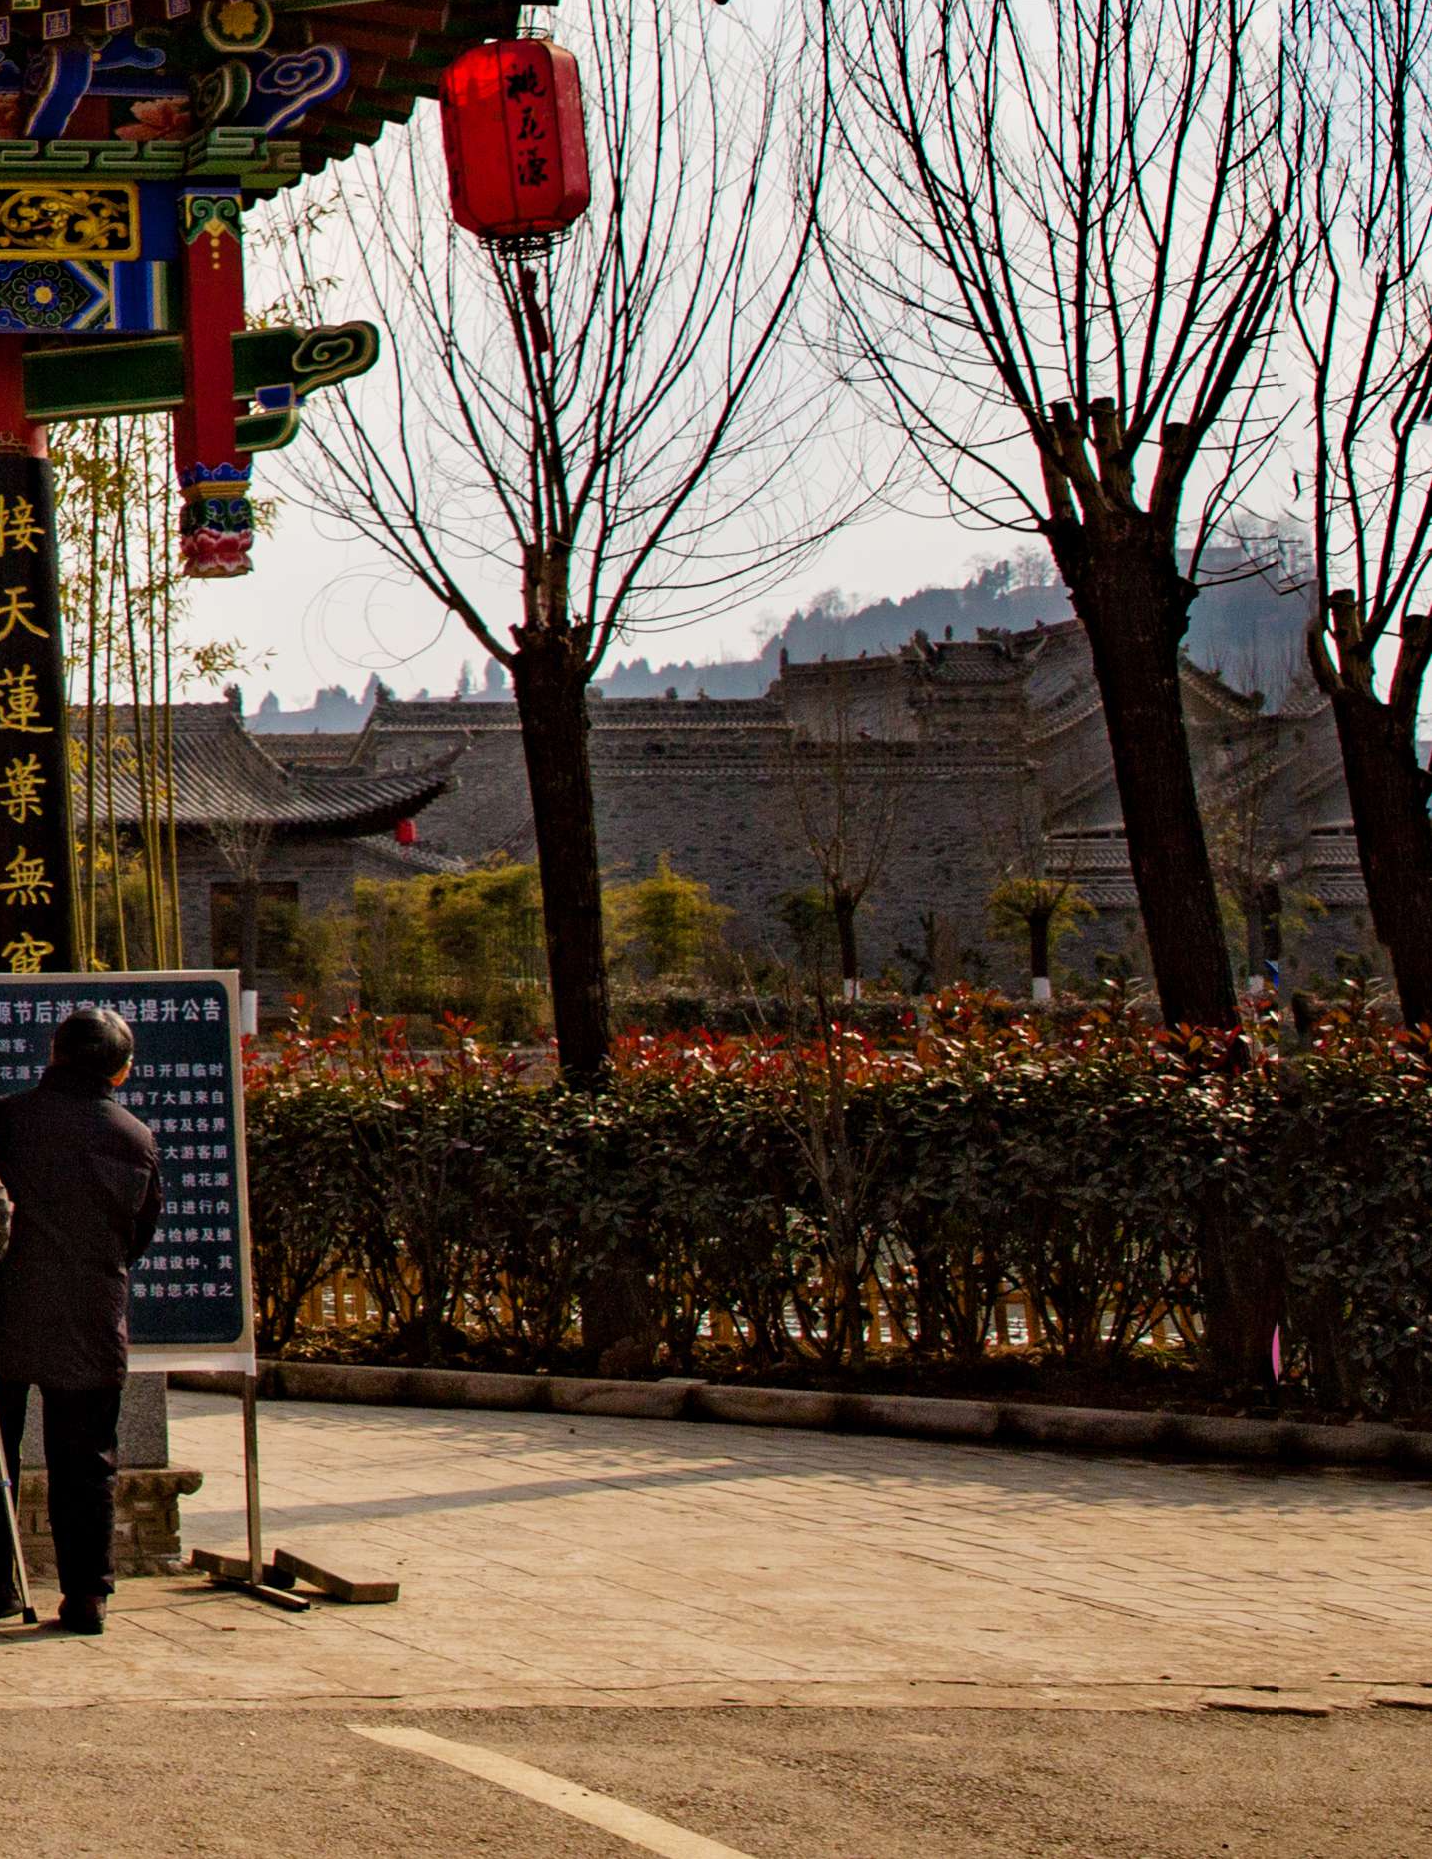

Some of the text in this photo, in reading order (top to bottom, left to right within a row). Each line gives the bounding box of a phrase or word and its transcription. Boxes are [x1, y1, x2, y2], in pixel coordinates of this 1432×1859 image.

[157, 1144, 228, 1160] 大游客朋
[160, 1199, 231, 1215] 日进行内
[129, 1254, 234, 1271] 力建设中，其
